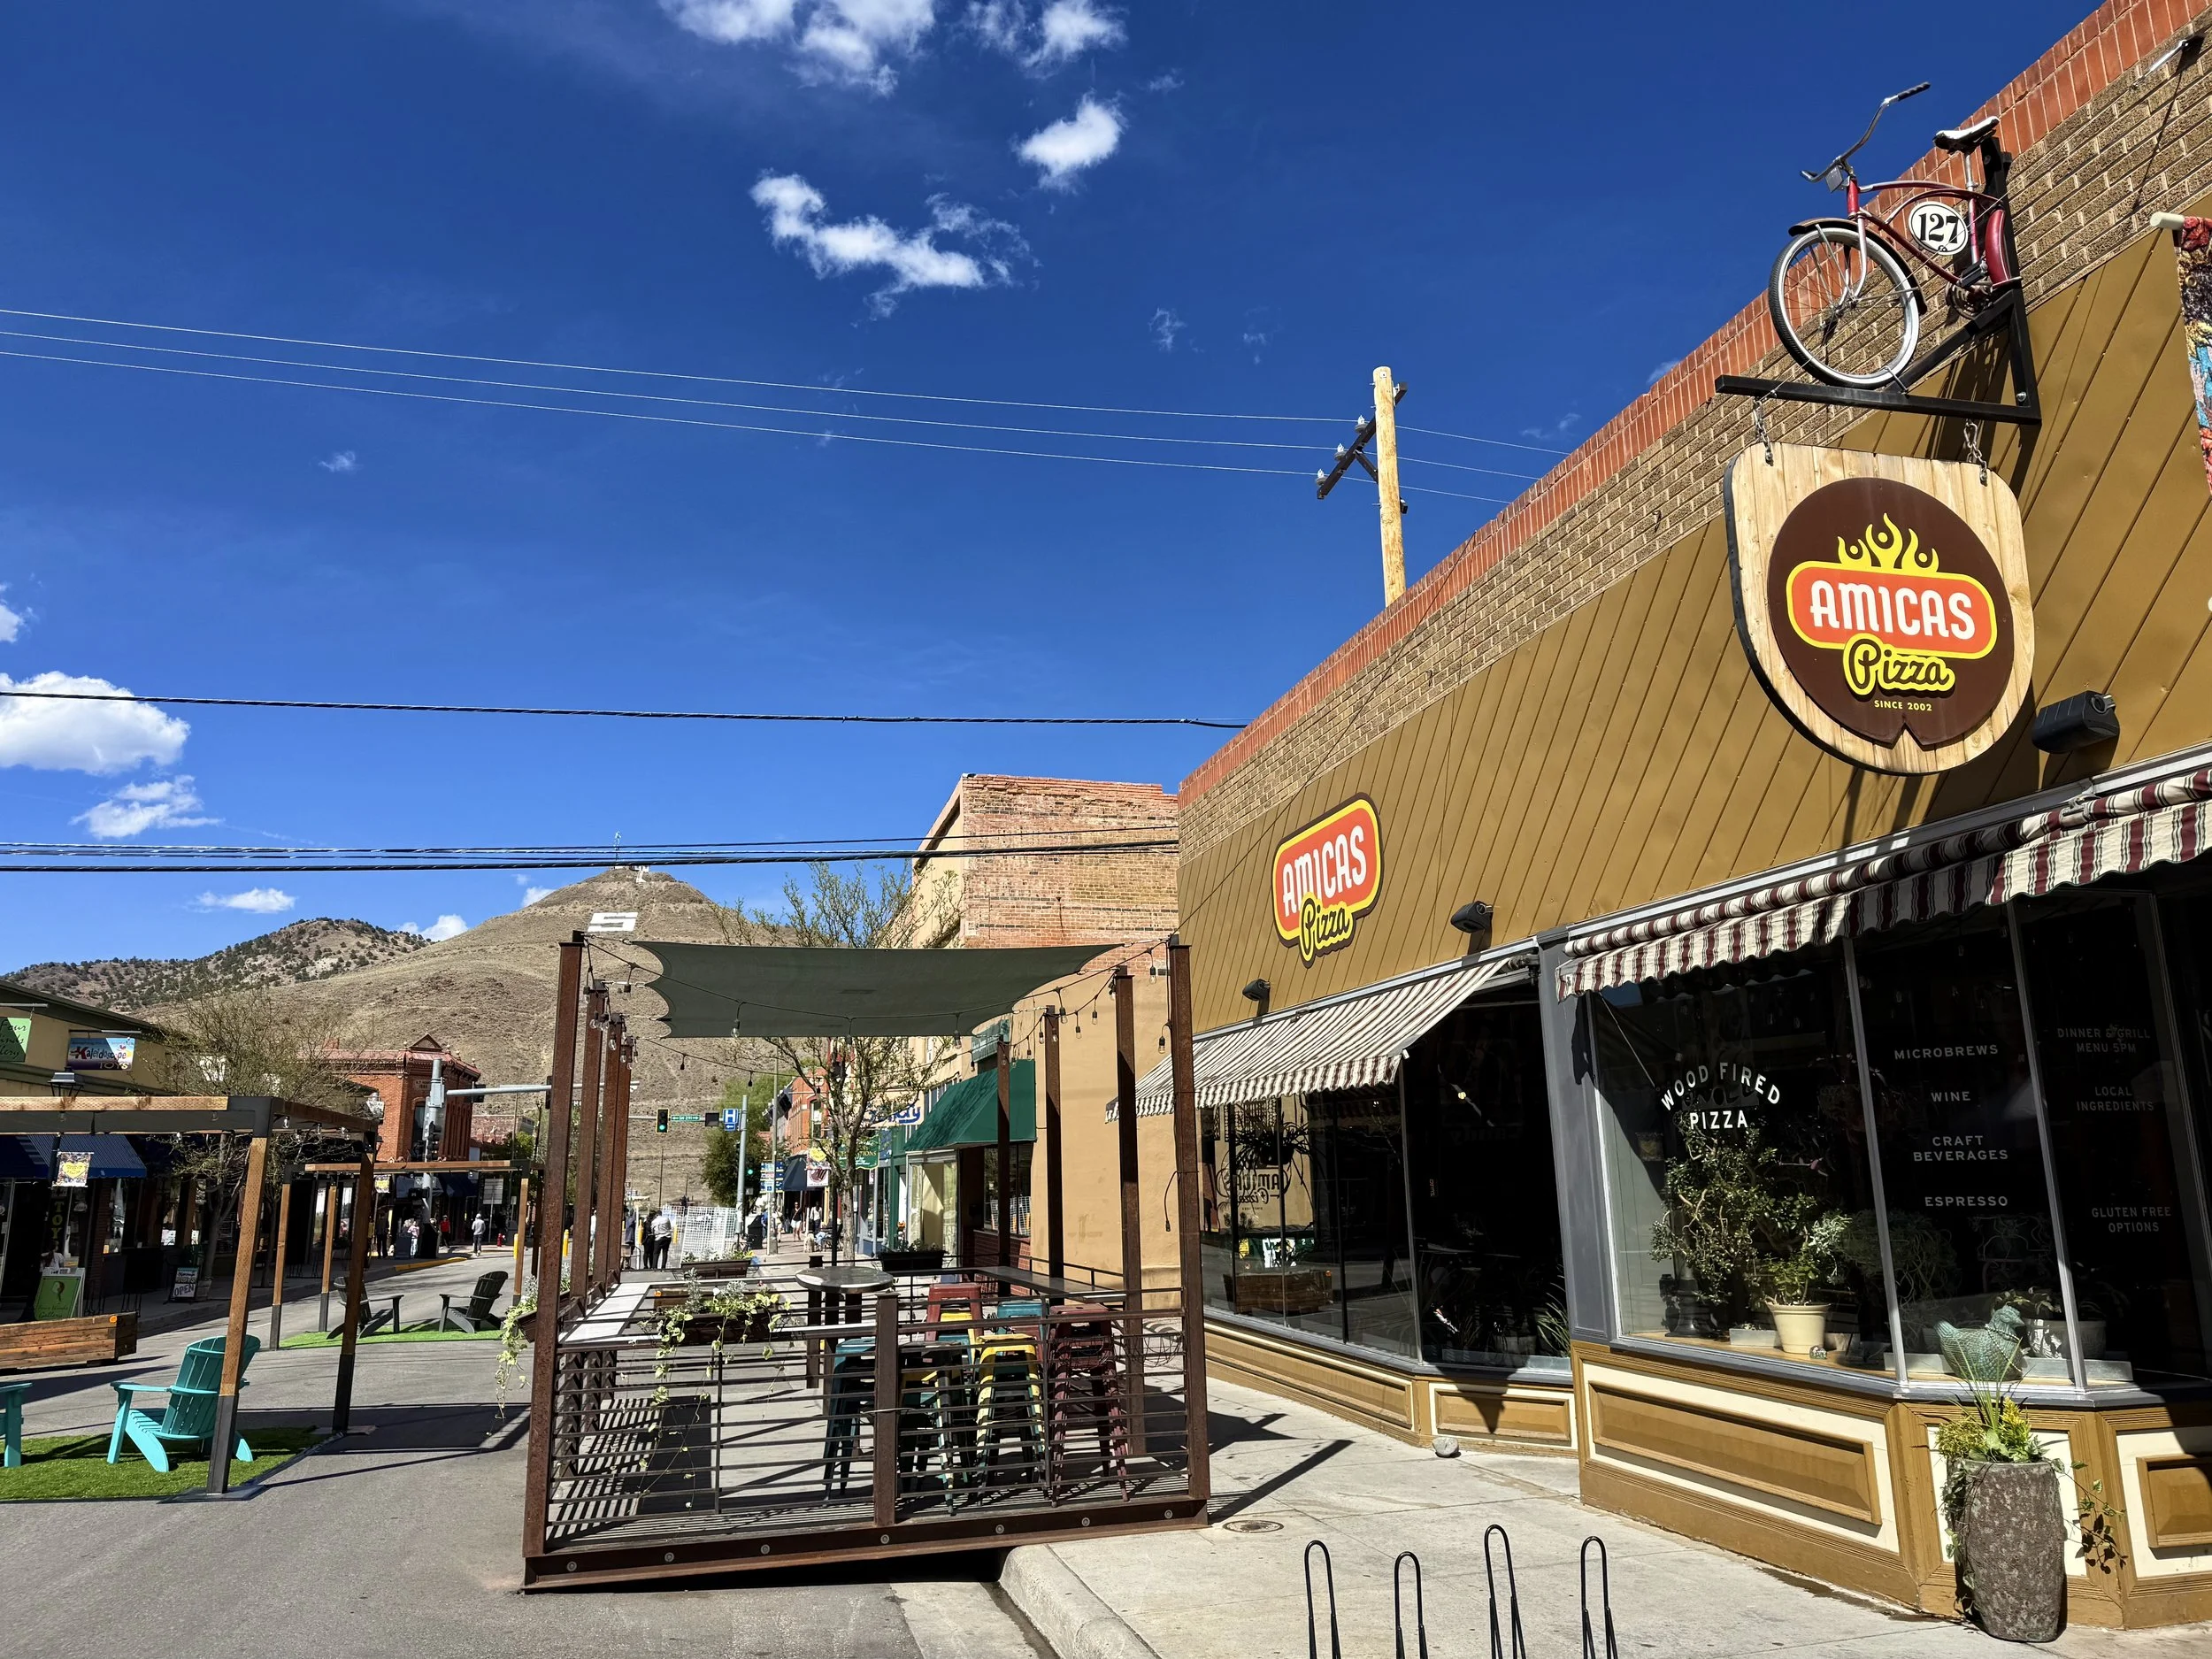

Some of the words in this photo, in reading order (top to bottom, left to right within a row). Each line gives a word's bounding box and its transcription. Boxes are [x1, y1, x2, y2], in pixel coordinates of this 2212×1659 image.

[1919, 213, 1959, 244] 127
[1810, 580, 1975, 640] AMICAS
[1848, 638, 1950, 690] Pizza
[1874, 700, 1902, 710] SINCE
[1907, 702, 1932, 711] 2002
[1283, 825, 1367, 918] AMICAS
[1301, 897, 1350, 956] Pizza
[2057, 1027, 2101, 1038] DINNER
[2116, 1028, 2151, 1039] GRILL
[74, 1046, 127, 1060] Kaleidoscope
[1894, 1044, 1999, 1060] MICROBREWS
[2076, 1042, 2108, 1053] MENU
[2113, 1043, 2137, 1053] 5PM
[1661, 1065, 1709, 1111] WOOD
[1719, 1062, 1780, 1104] FIRED
[2094, 1087, 2133, 1096] LOCAL
[1931, 1091, 1971, 1102] WINE
[2076, 1101, 2154, 1111] INGREDIENTS
[725, 1110, 736, 1123] H
[1690, 1110, 1747, 1130] PIZZA
[1932, 1135, 1984, 1147] CRAFT
[1913, 1149, 2008, 1162] BEVERAGES
[1924, 1195, 2008, 1207] ESPRESSO
[2091, 1206, 2138, 1218] GLUTEN
[2141, 1206, 2172, 1217] FREE
[2108, 1221, 2160, 1233] OPTIONS
[174, 1284, 194, 1296] OPEN
